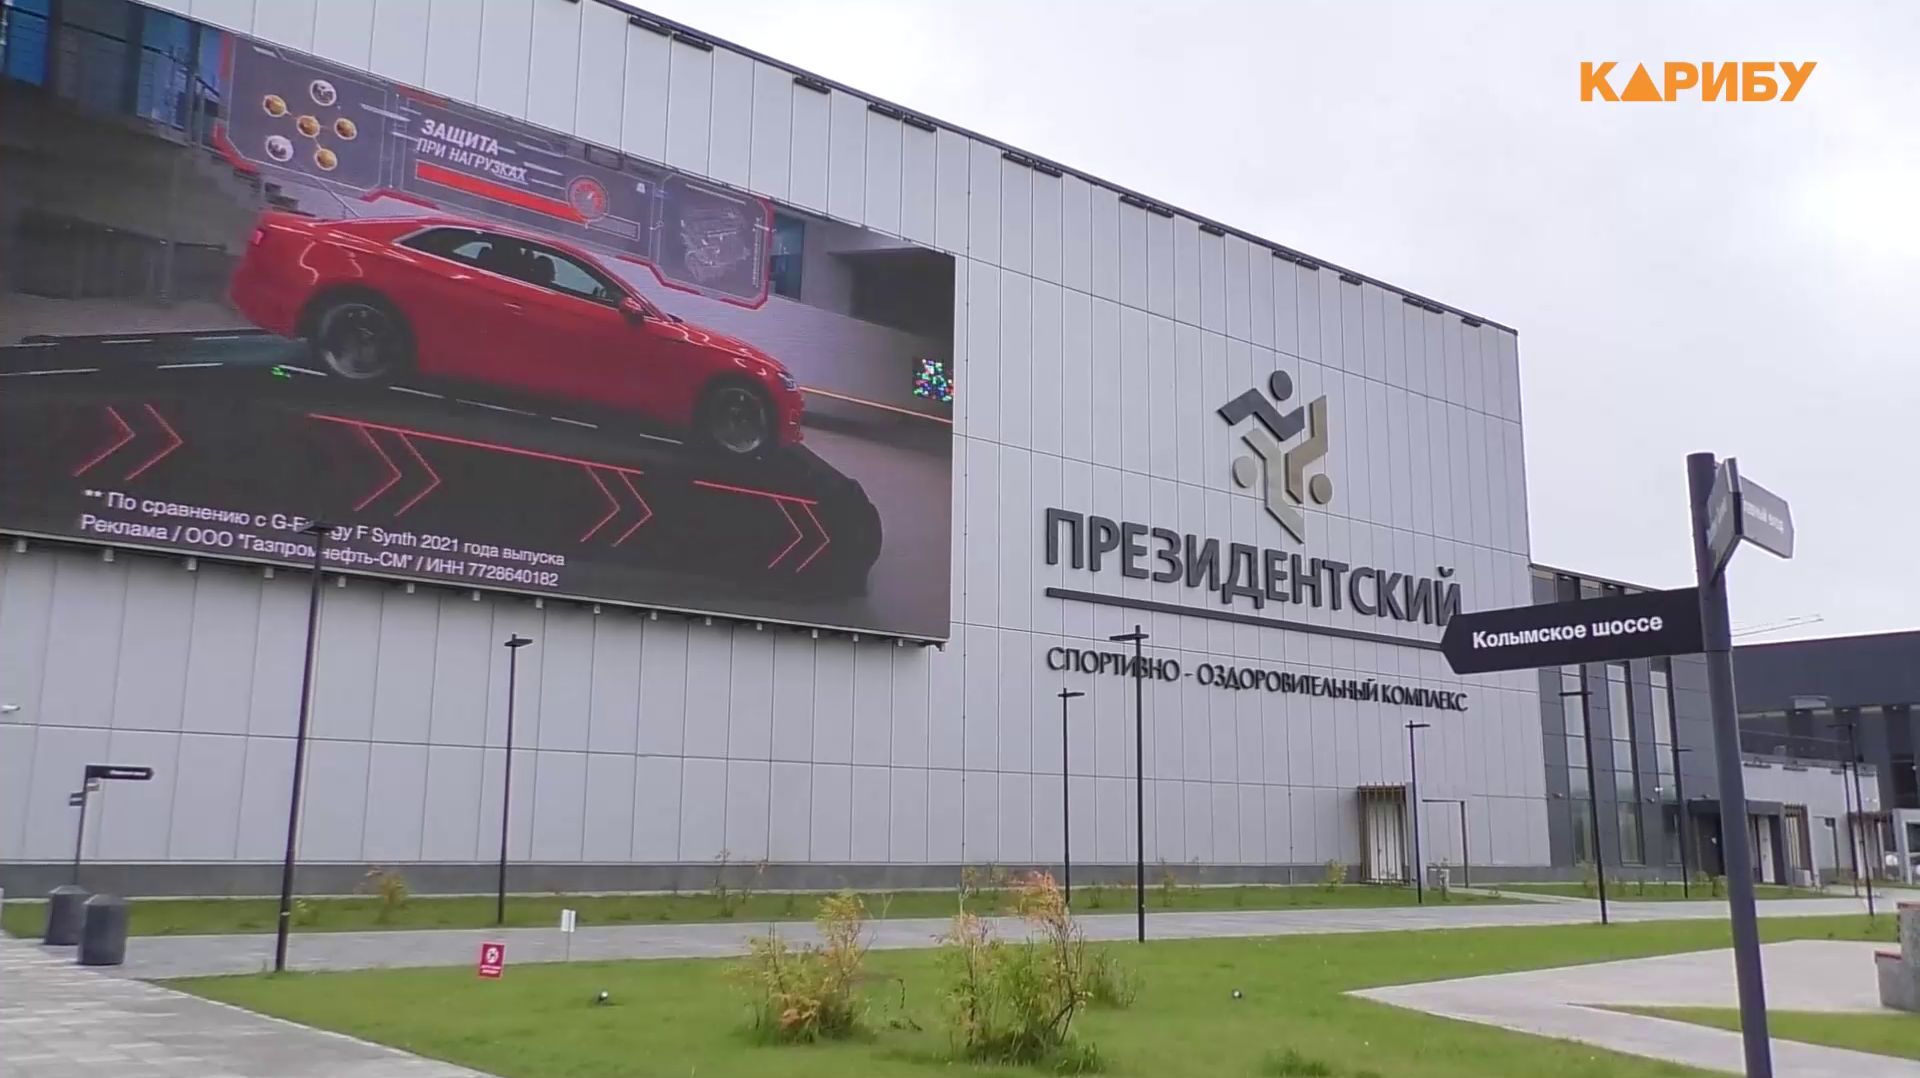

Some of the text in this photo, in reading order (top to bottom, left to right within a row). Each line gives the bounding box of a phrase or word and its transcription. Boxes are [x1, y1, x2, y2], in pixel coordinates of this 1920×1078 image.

[416, 137, 528, 183] ПРИ НАГРУЗКАХ
[421, 119, 499, 156] ЗАЩИТА
[80, 514, 168, 541] Реклама
[185, 527, 234, 548] ООО
[426, 557, 465, 576] ИНН
[467, 562, 559, 588] 7728640182
[107, 491, 137, 511] По
[142, 499, 250, 526] сравнению
[254, 514, 267, 527] с
[356, 525, 369, 540] F
[372, 527, 417, 548] Synth
[420, 534, 459, 553] 2021
[463, 542, 499, 559] года
[503, 547, 566, 567] выпуска
[1045, 507, 1463, 627] ПРЕЗИДЕНТСКИЙ
[1472, 614, 1664, 650] Колымское шоссе
[1047, 646, 1181, 683] СПОРТИВНО
[1197, 662, 1379, 703] ОЗДОРОВИТЕЛЬНЫЙ
[1380, 683, 1470, 713] КОМПЛЕКС
